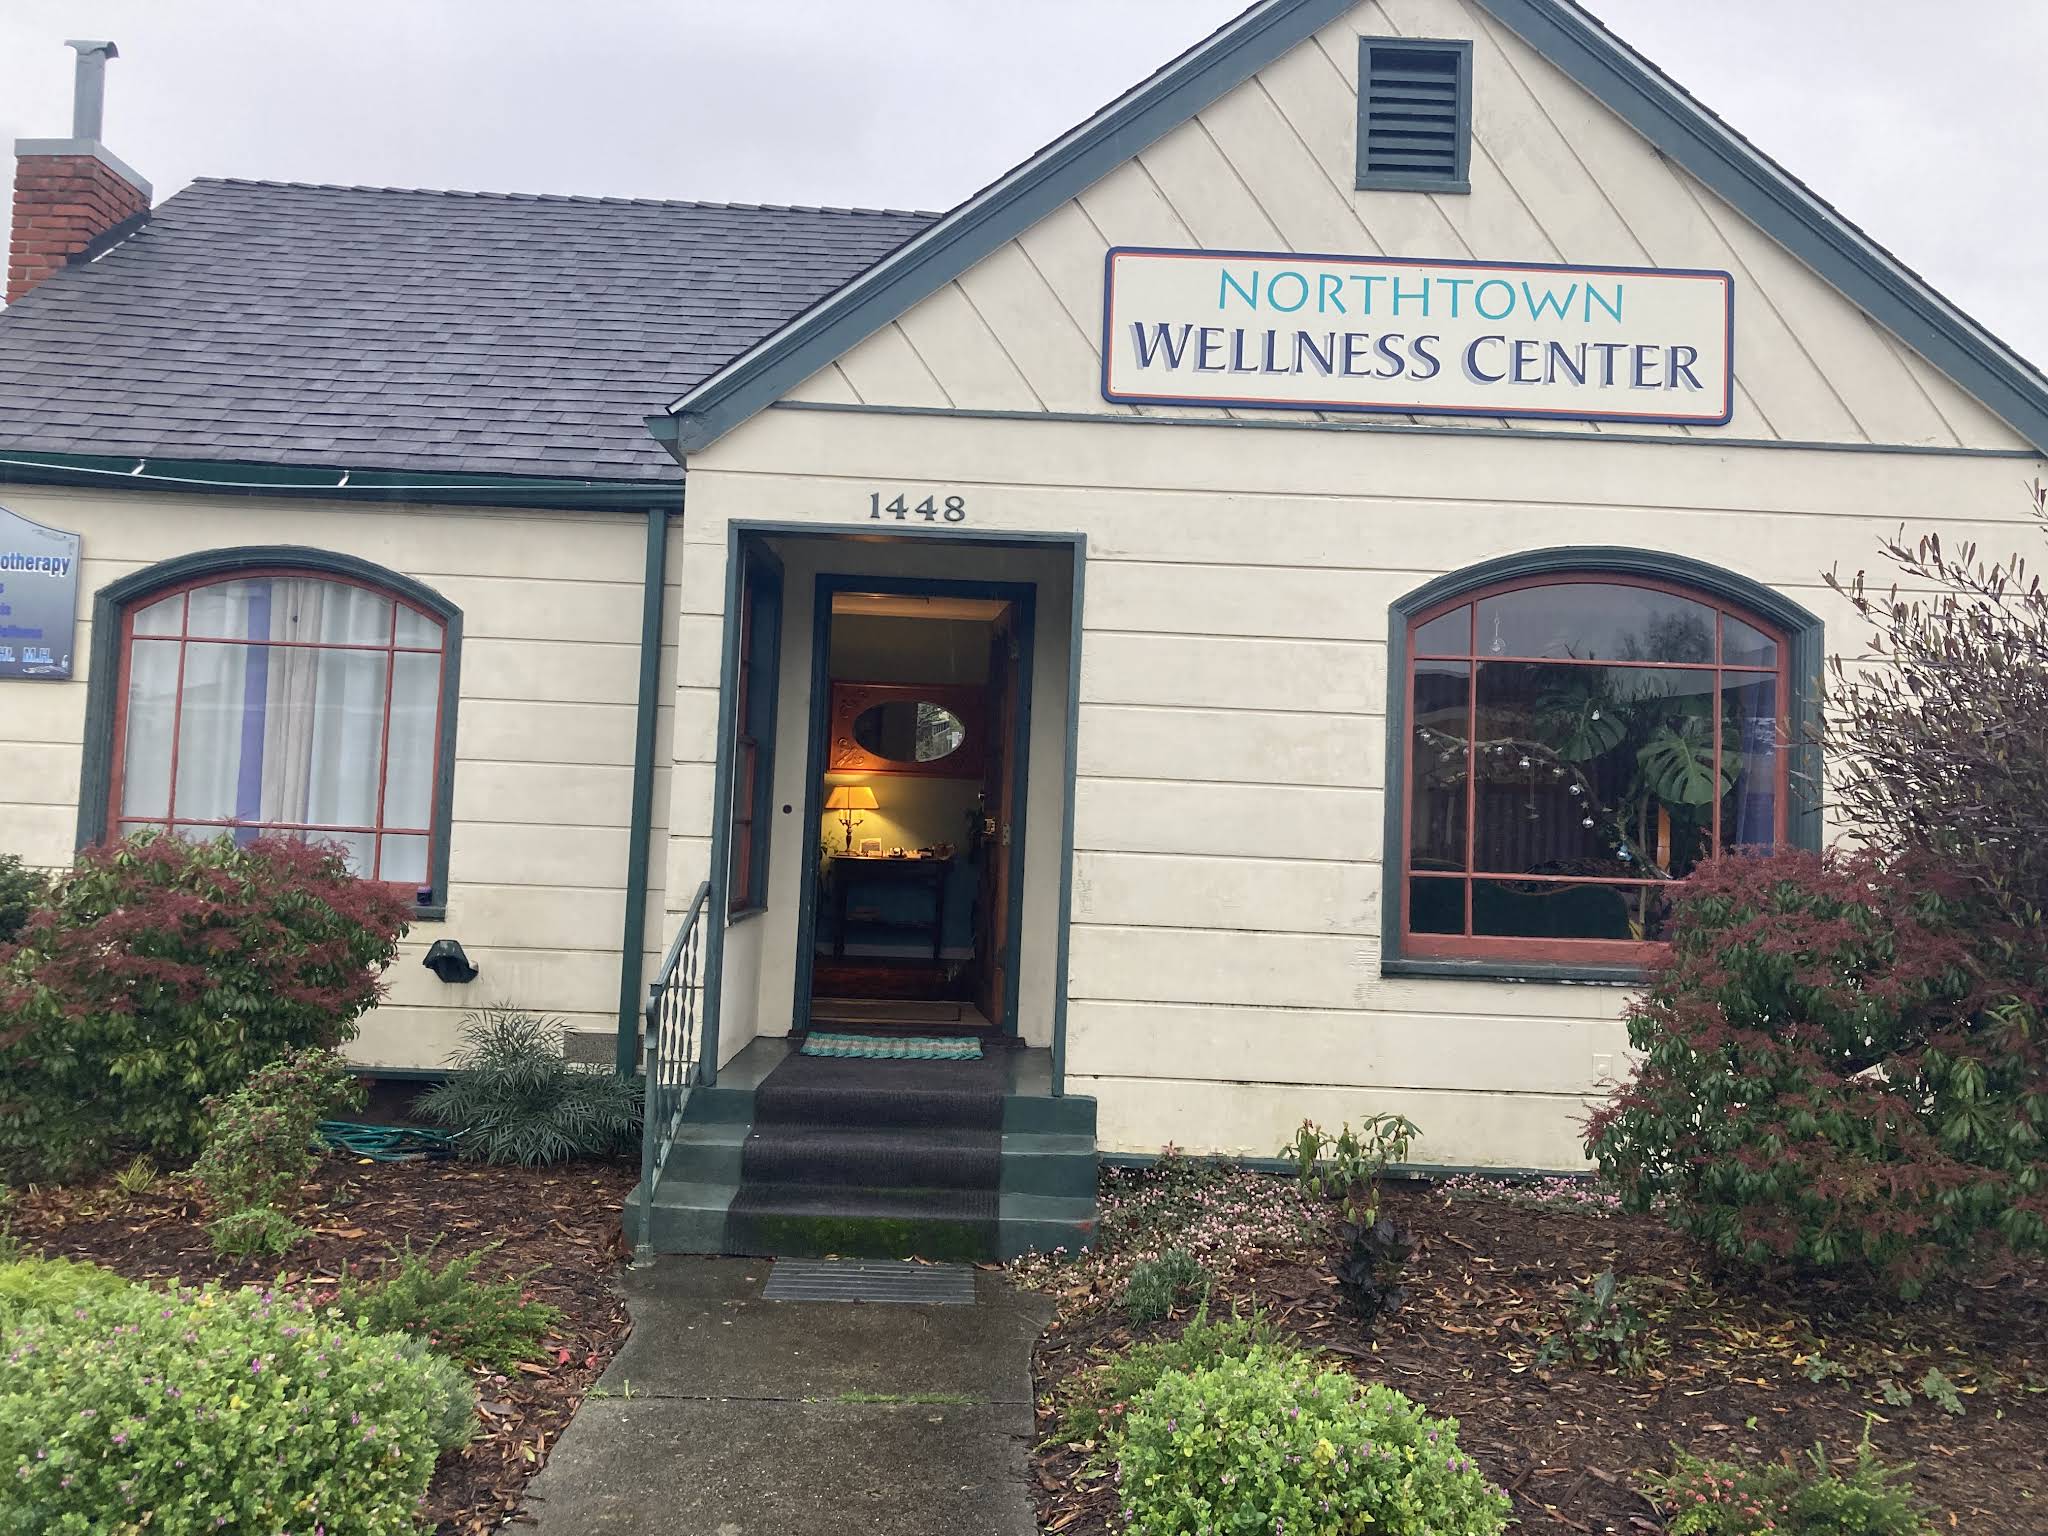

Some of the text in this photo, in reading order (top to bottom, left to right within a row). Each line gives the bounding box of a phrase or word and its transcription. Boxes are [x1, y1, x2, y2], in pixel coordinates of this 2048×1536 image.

[1219, 268, 1623, 324] NORTHTOWN
[1132, 322, 1704, 390] WELLNESS CENTER
[870, 492, 966, 522] 1448
